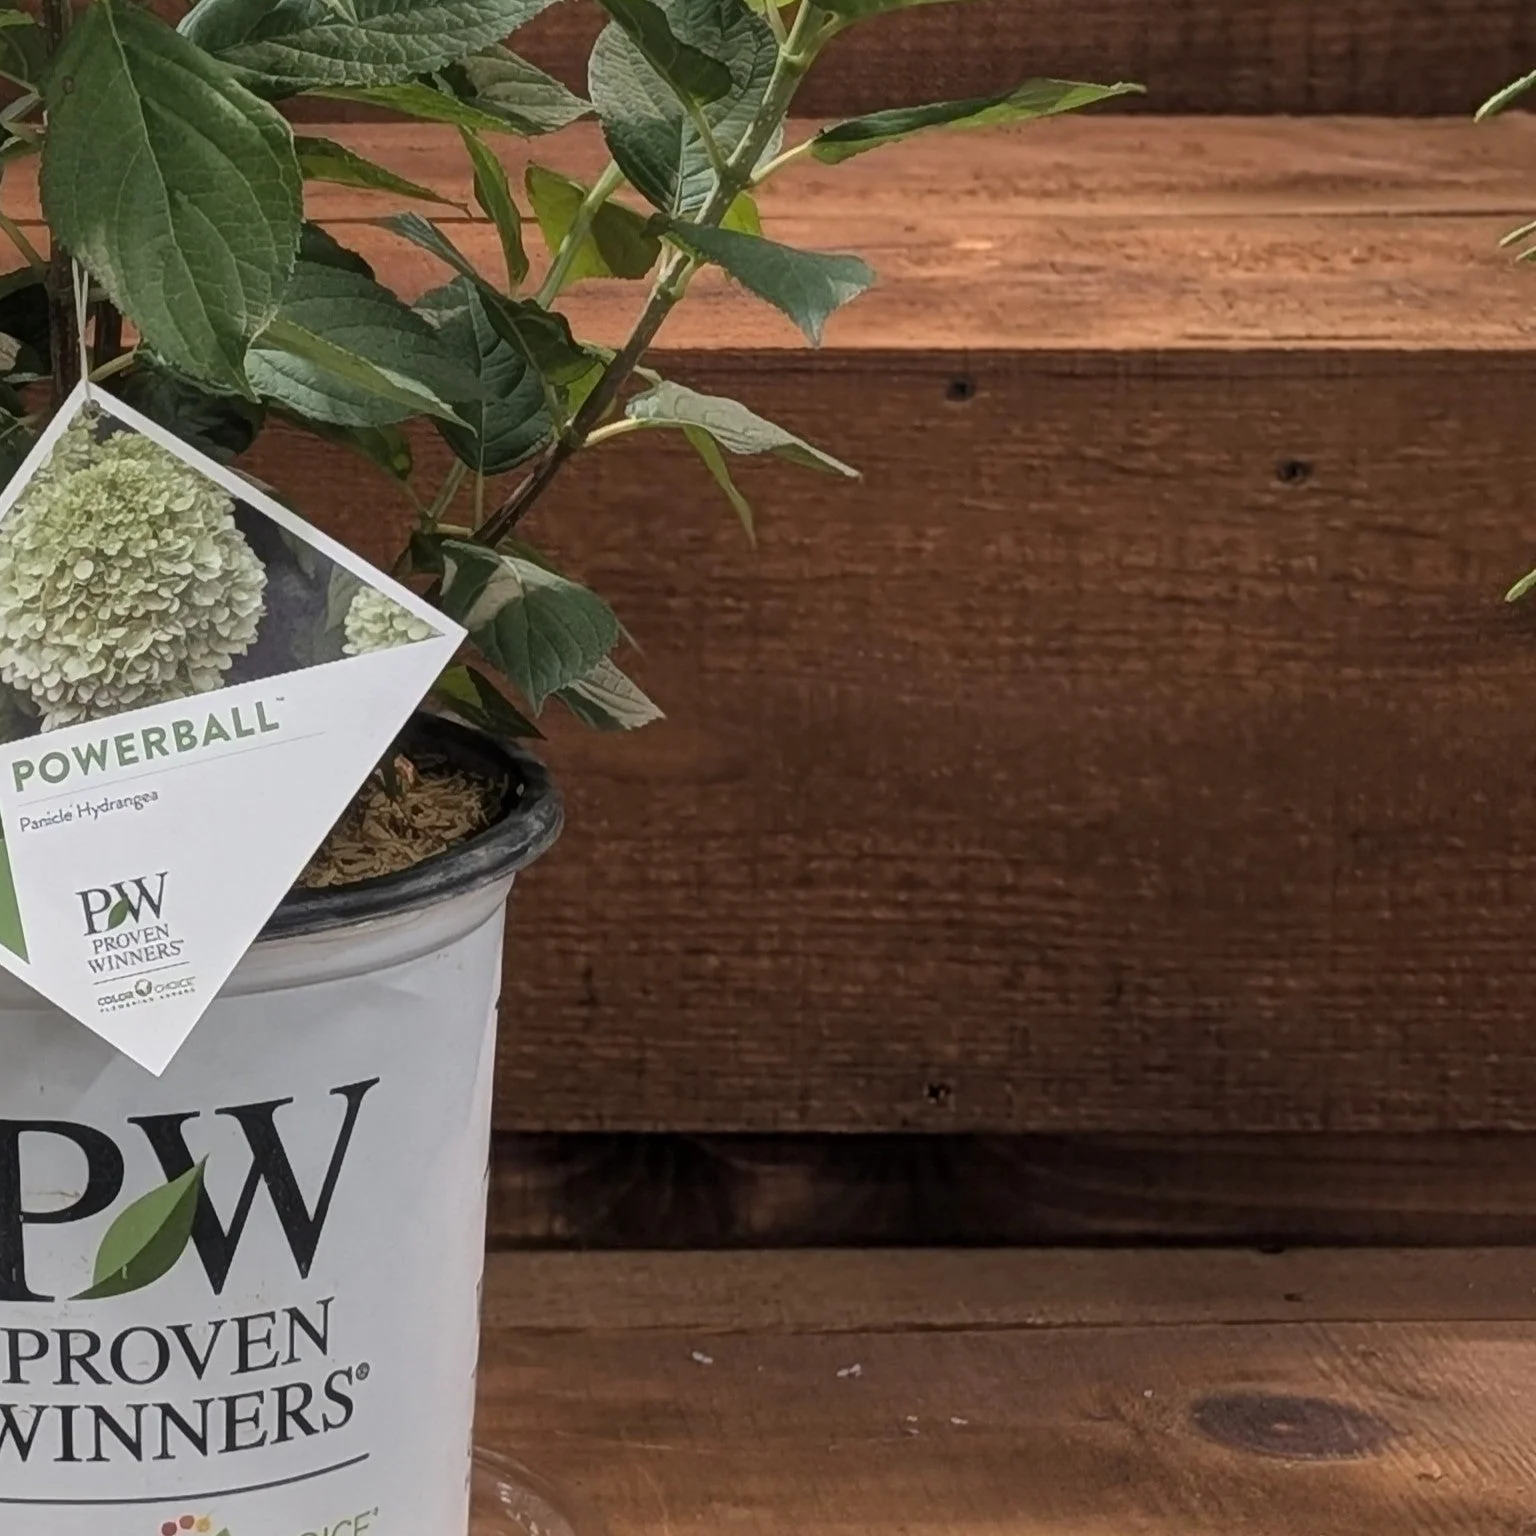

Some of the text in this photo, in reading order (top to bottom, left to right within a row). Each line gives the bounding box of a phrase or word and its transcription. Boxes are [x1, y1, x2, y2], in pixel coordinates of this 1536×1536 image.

[20, 790, 159, 833] Panicle Hydrangea
[75, 871, 169, 936] PW
[92, 923, 170, 955] PROVEN
[0, 1296, 335, 1386] PROVEN
